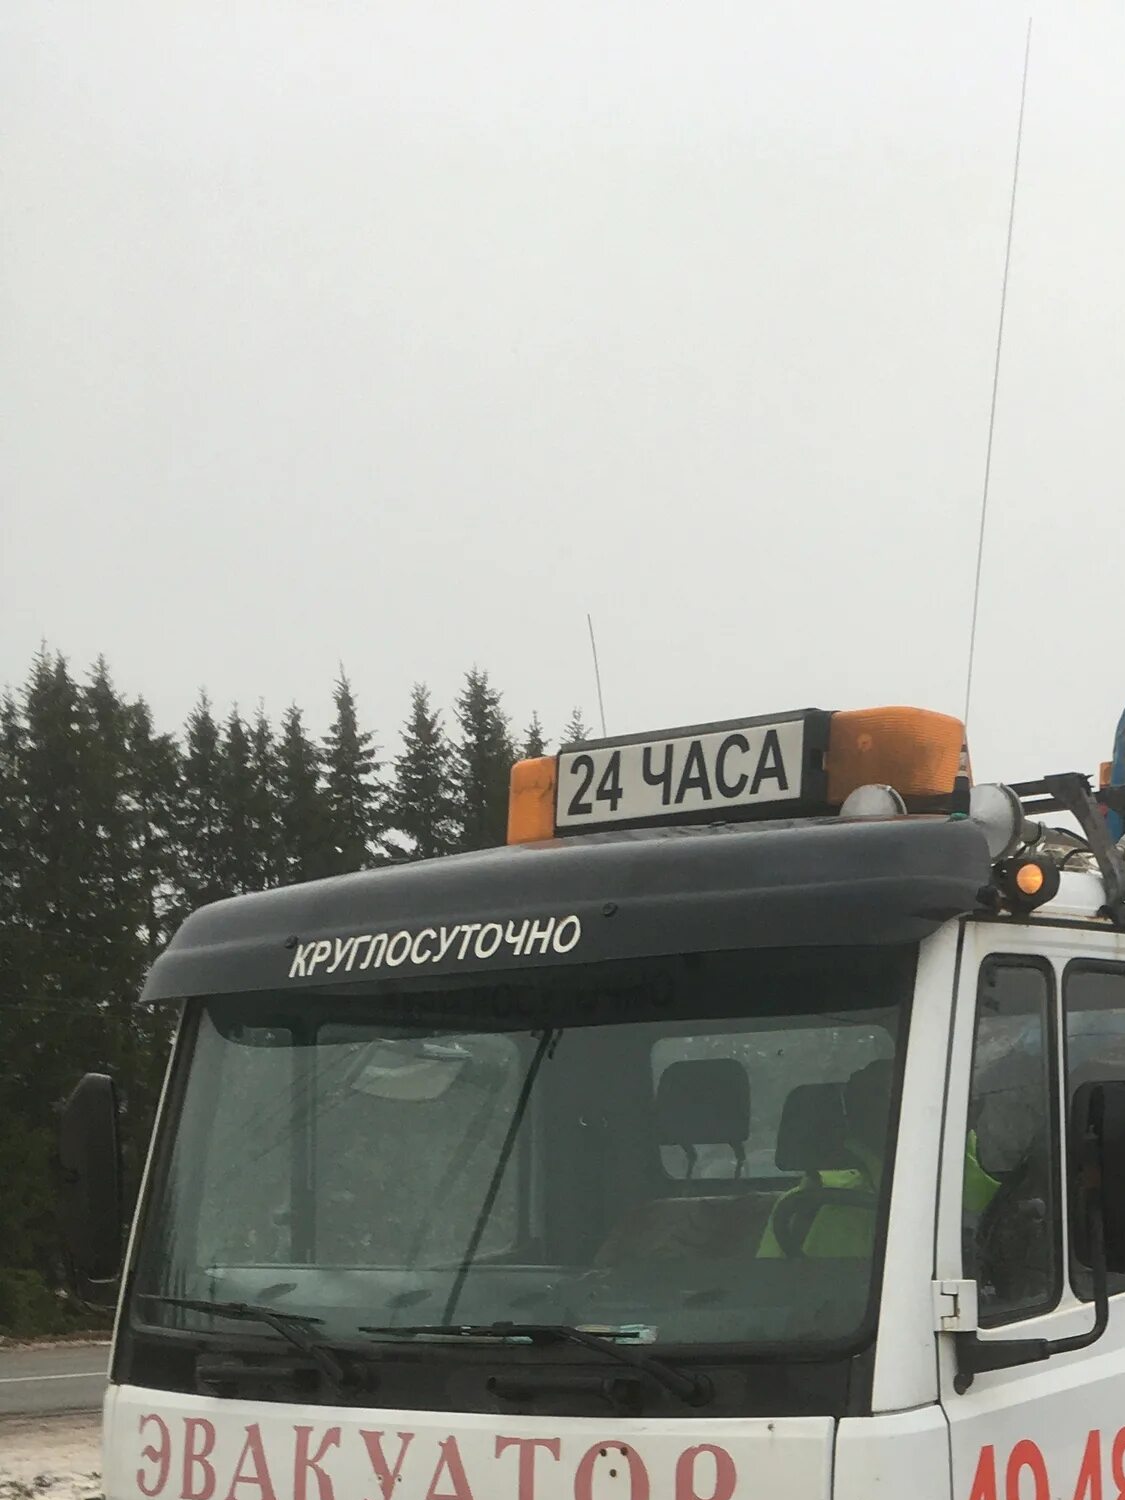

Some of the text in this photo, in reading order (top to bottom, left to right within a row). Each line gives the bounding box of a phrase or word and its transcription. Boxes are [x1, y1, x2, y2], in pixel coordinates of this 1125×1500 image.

[568, 729, 789, 816] 24 ЧАСА
[288, 915, 581, 978] КРУГЛОСУТОЧНО
